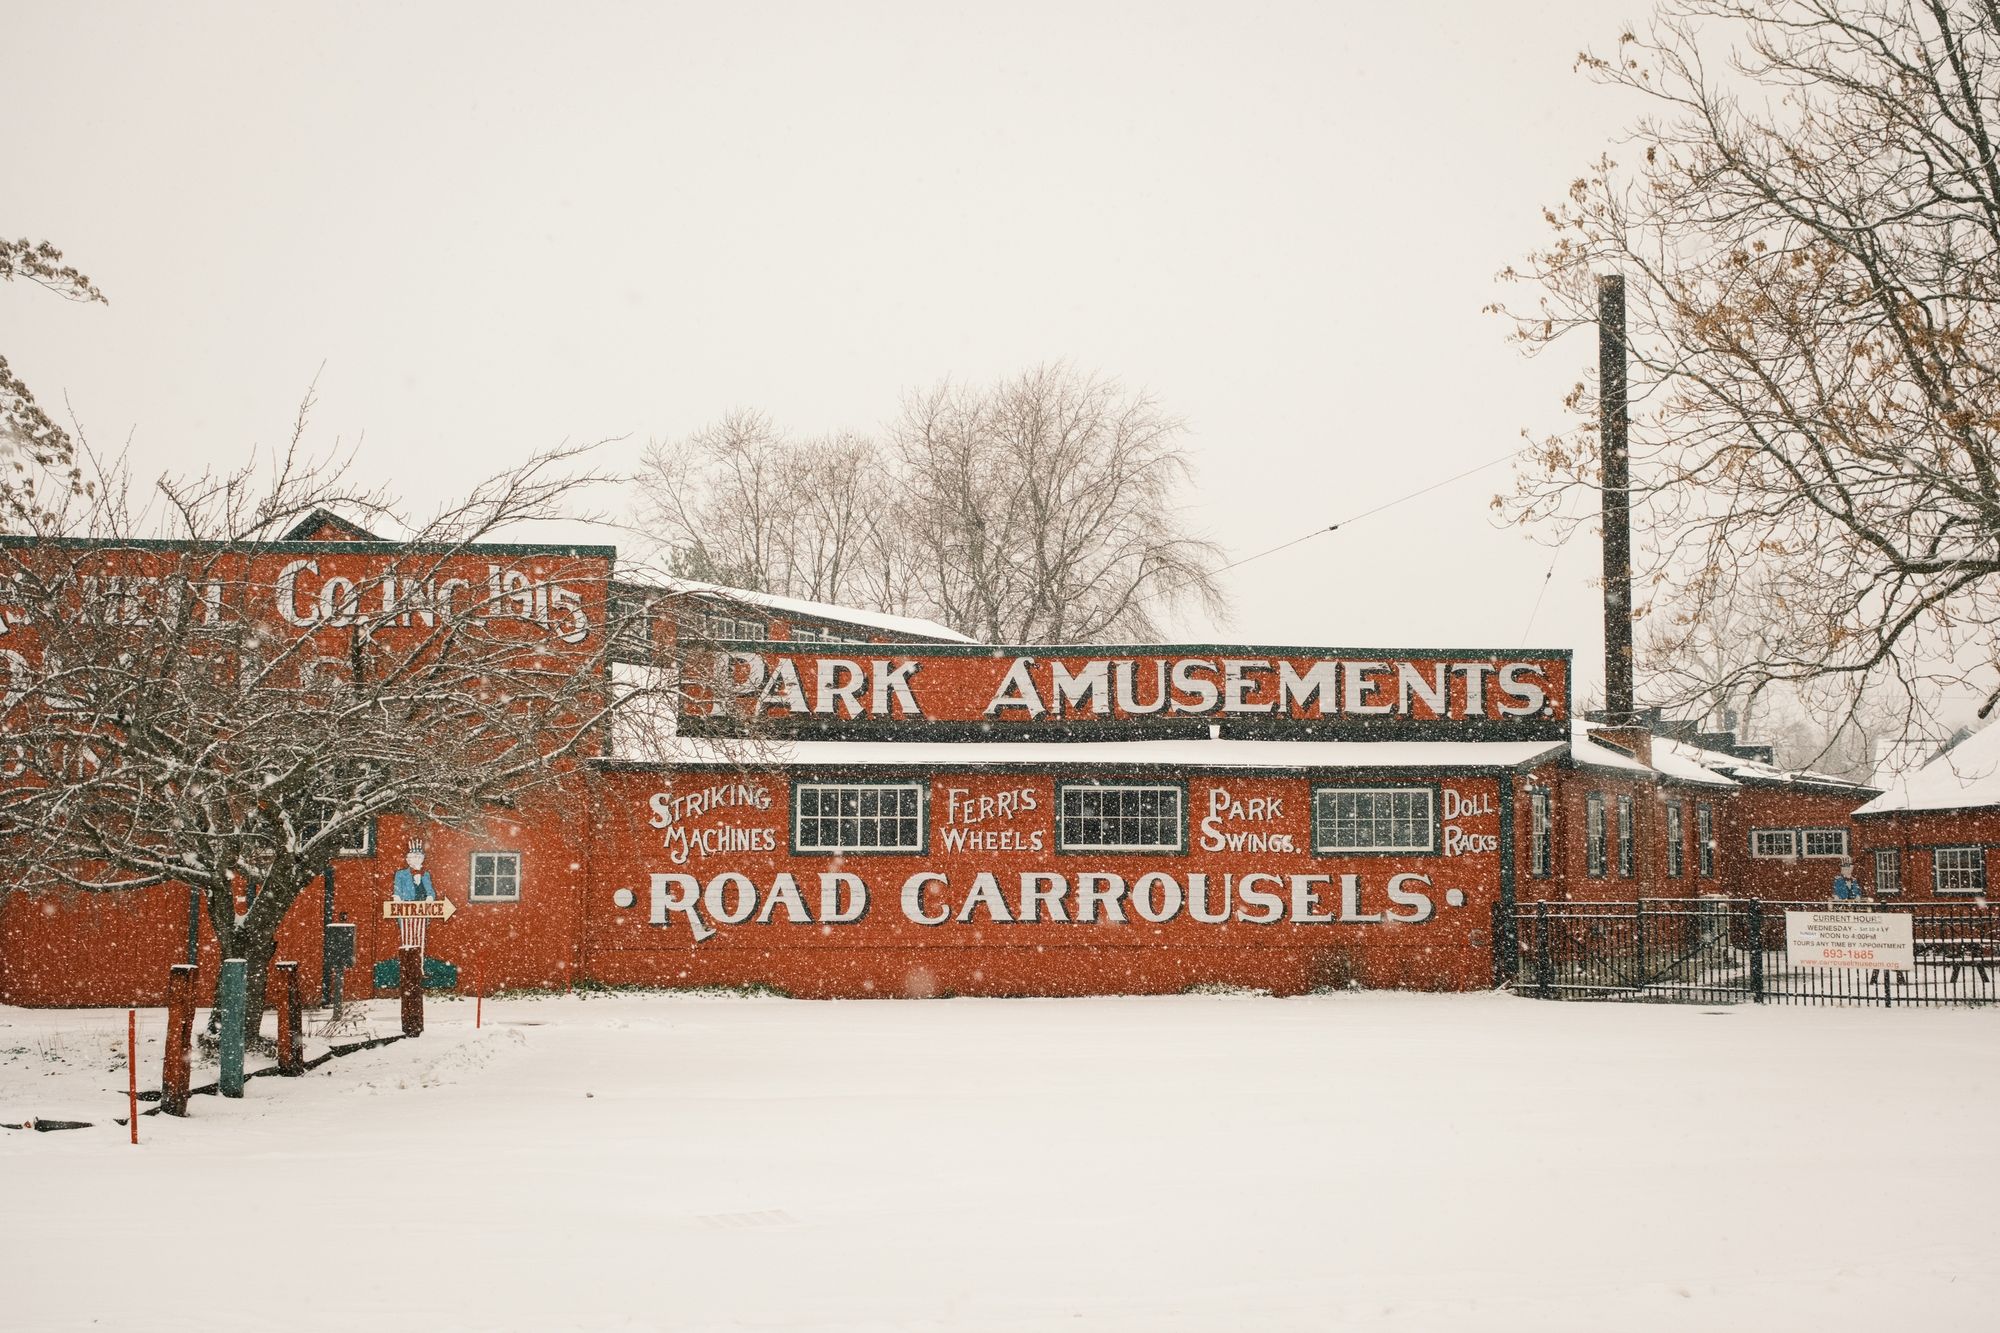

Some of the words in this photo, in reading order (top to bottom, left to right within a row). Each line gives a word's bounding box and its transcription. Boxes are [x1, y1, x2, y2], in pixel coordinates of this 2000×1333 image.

[488, 564, 588, 644] 1915
[711, 652, 921, 720] PARK
[648, 784, 772, 829] STRIKING
[948, 788, 1037, 826] FERRIS
[1209, 788, 1283, 823] PARK
[1444, 789, 1493, 821] DOLL
[664, 825, 776, 864] MACHINES
[940, 827, 1043, 855] WHEELS
[1444, 824, 1498, 857] RACKS
[390, 903, 444, 917] ENTRANCE
[648, 872, 867, 941] ROAD
[901, 872, 1434, 926] CARROUSELS
[1812, 914, 1850, 922] CURRENT
[1807, 924, 1852, 932] WEDNESDAY
[1823, 948, 1874, 959] 693-1885
[1859, 942, 1906, 950] APPOINTMENT
